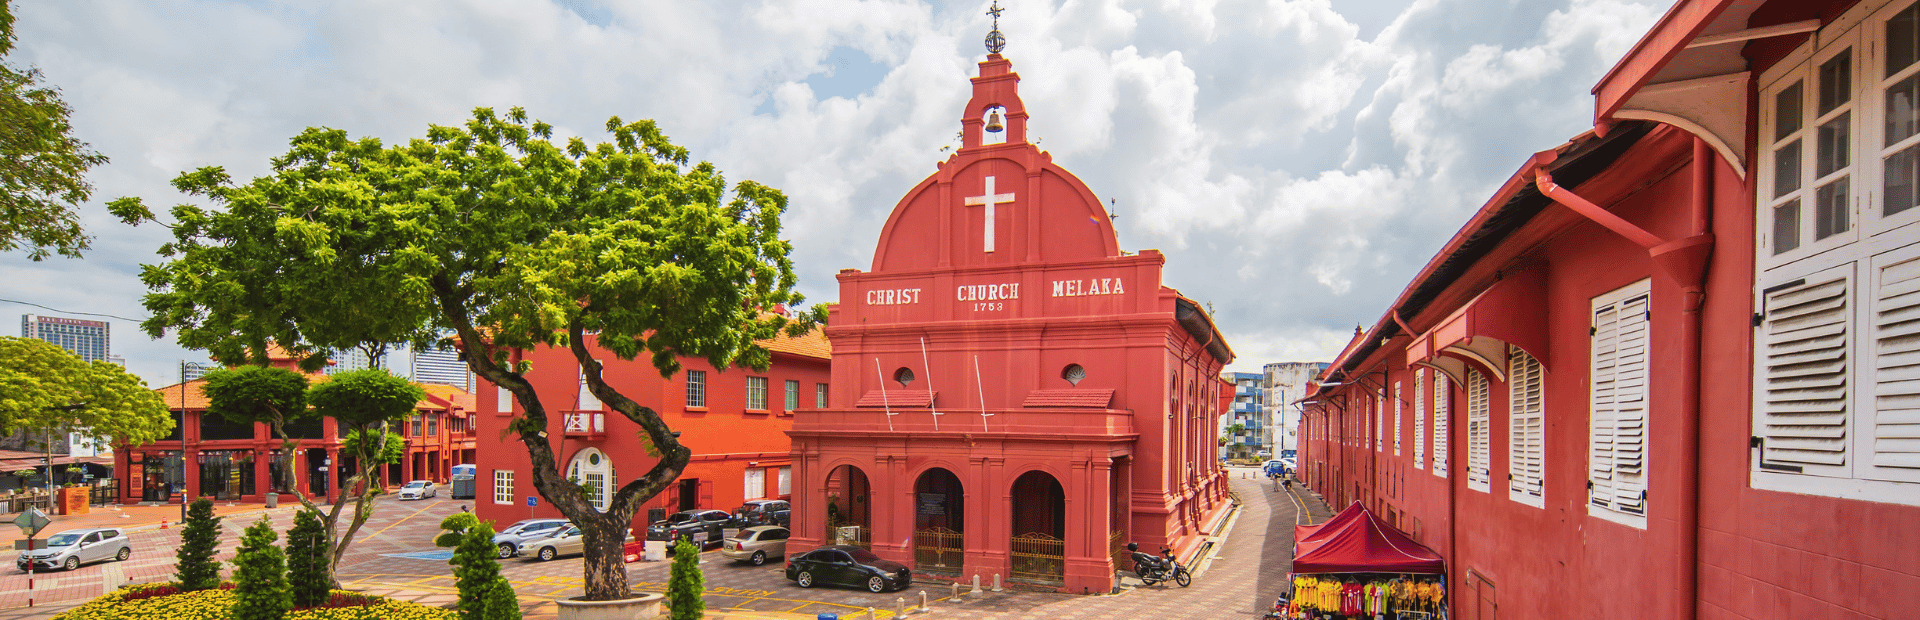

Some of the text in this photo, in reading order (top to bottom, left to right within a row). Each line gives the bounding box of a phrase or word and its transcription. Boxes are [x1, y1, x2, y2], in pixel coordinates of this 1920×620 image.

[867, 278, 1124, 305] CHRIST CHURCH MELAKA
[974, 302, 1003, 312] 1753
